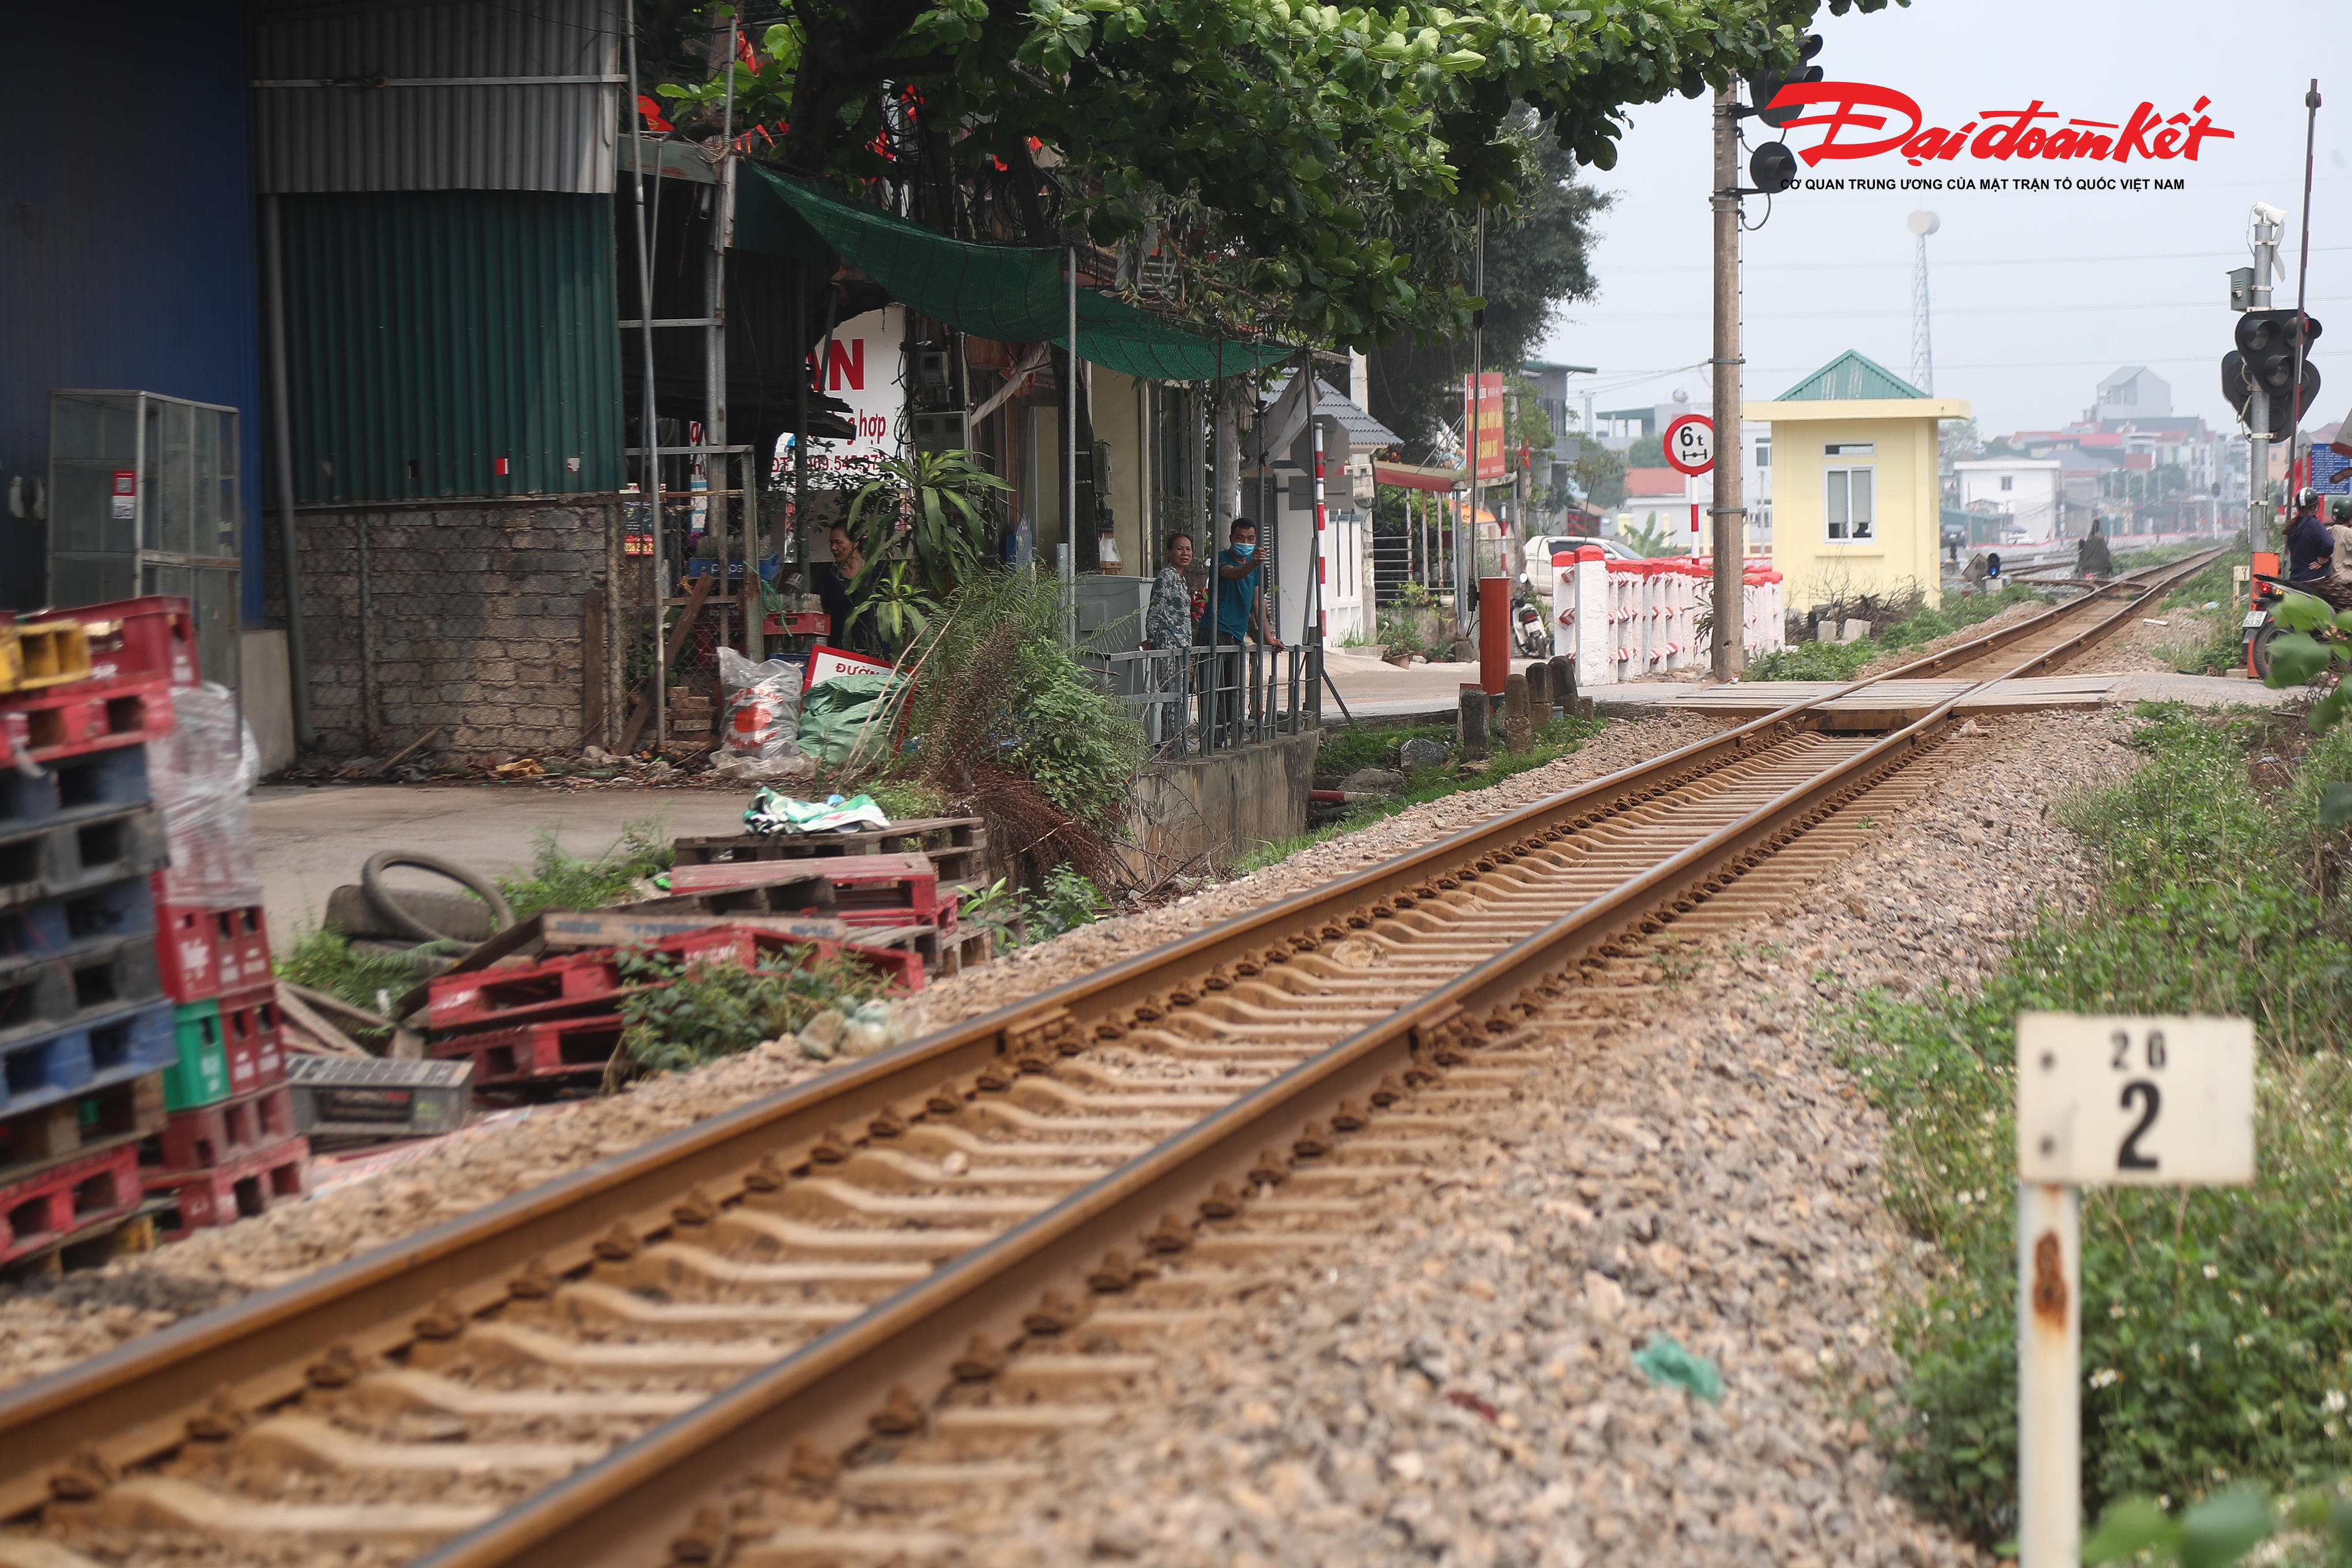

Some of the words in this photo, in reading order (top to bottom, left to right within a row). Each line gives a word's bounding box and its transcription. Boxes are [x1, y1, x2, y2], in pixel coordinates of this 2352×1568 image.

[859, 409, 886, 445] hợp
[710, 563, 744, 574] pps
[2117, 1079, 2162, 1170] 2
